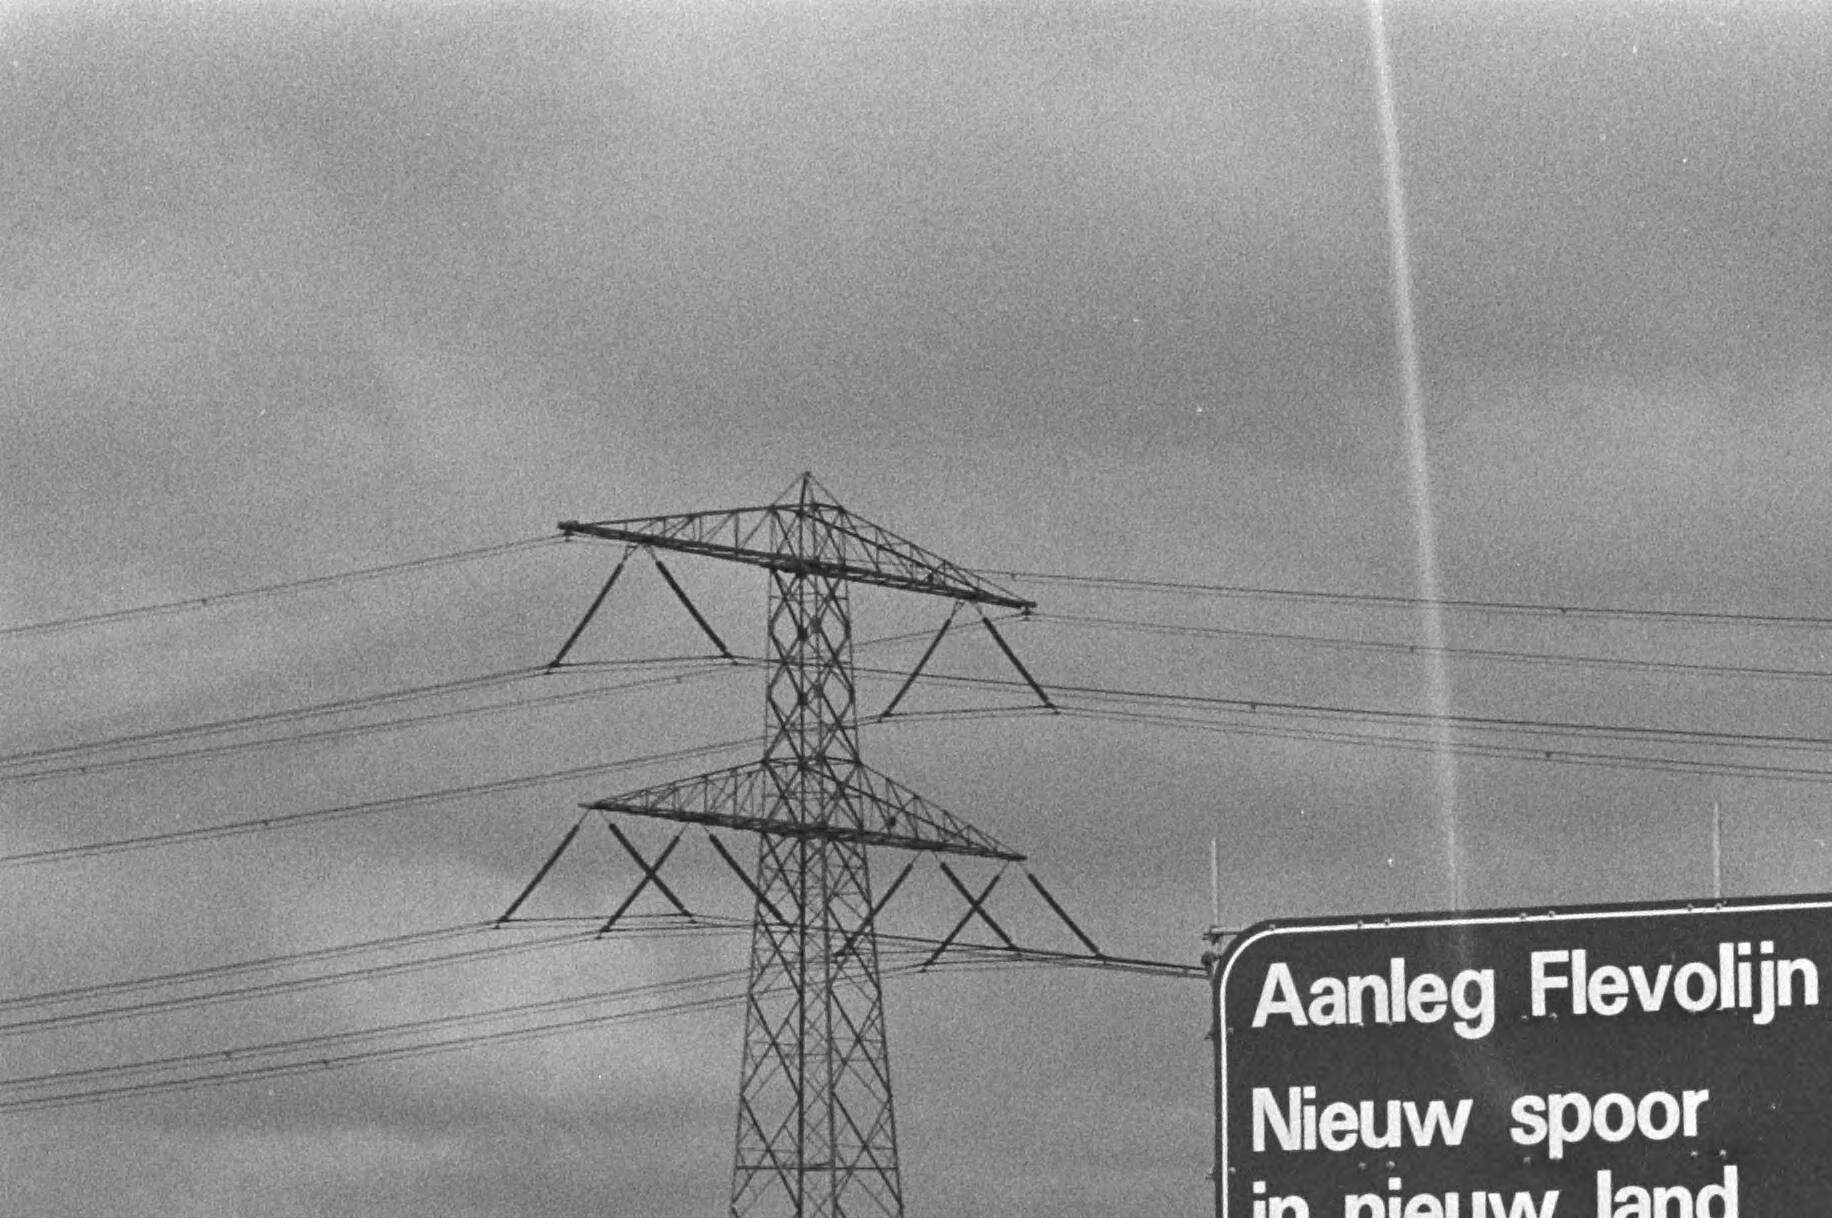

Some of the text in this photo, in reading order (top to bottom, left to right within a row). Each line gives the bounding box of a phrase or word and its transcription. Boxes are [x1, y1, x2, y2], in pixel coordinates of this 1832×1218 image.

[1252, 940, 1819, 1039] Aanleg Flevolijn
[1252, 1086, 1710, 1159] Nieuw spoor
